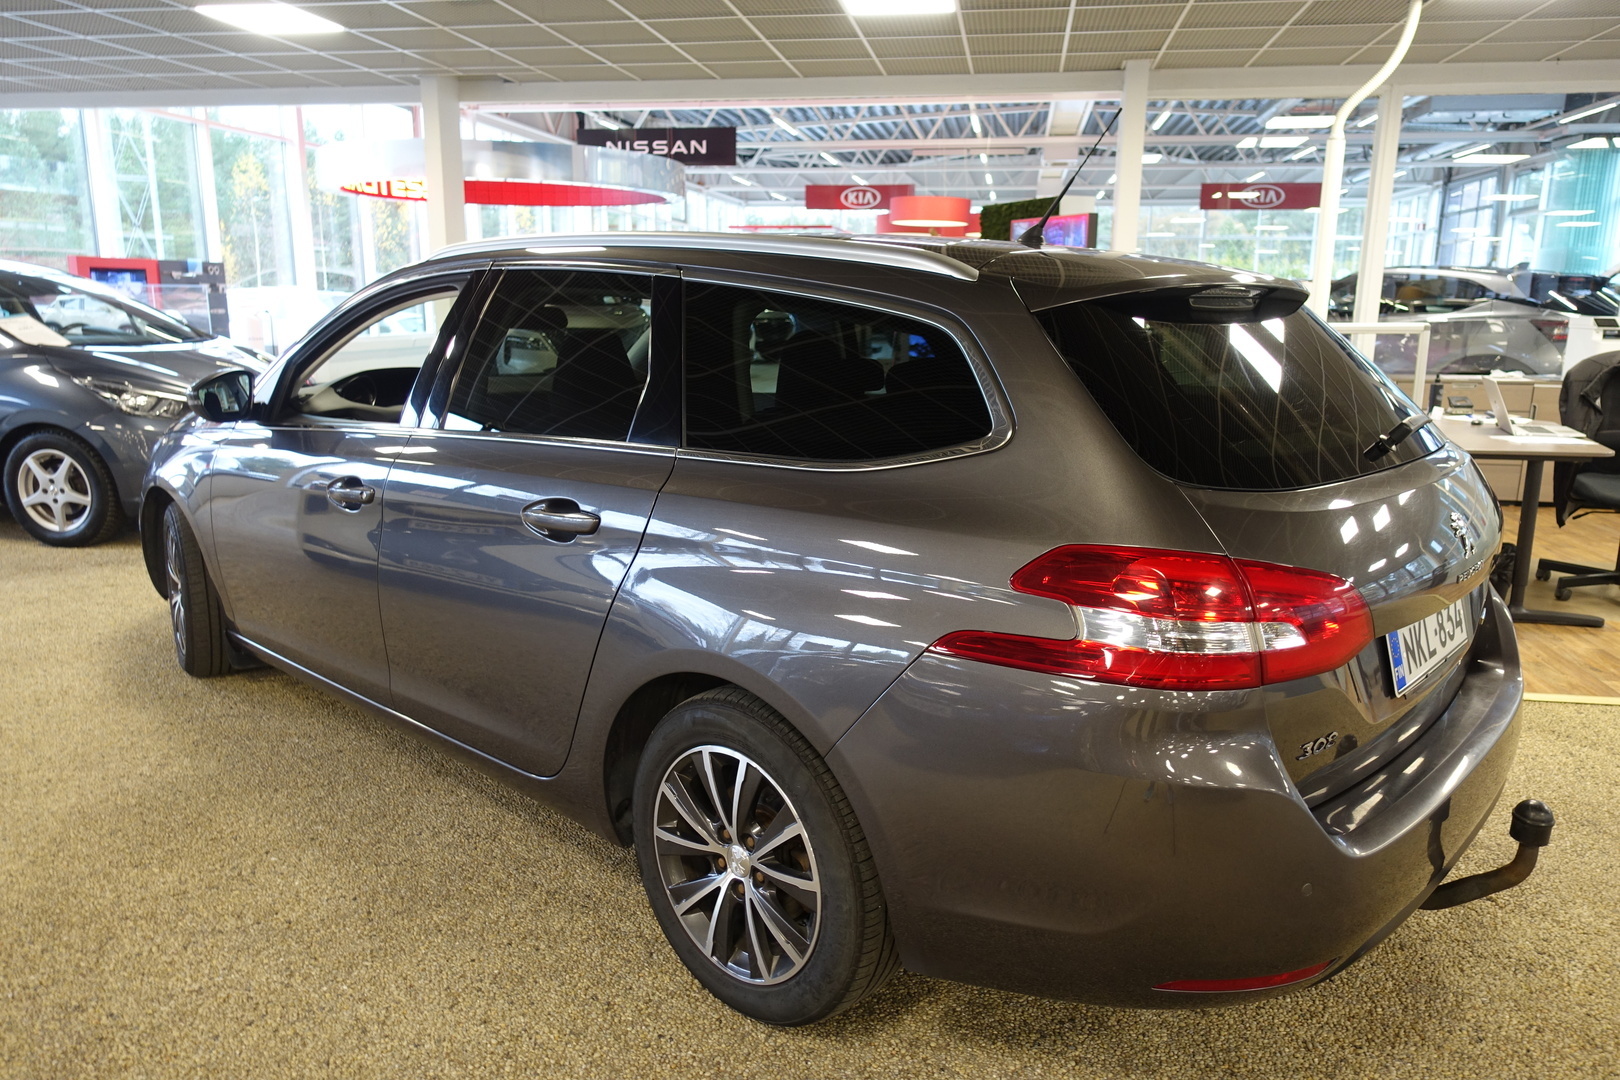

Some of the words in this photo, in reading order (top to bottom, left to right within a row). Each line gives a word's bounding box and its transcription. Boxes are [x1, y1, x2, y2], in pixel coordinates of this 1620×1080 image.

[605, 140, 707, 154] NISSAN
[845, 190, 877, 206] KIA
[1403, 602, 1464, 675] NKL-834
[1296, 731, 1339, 760] 308
